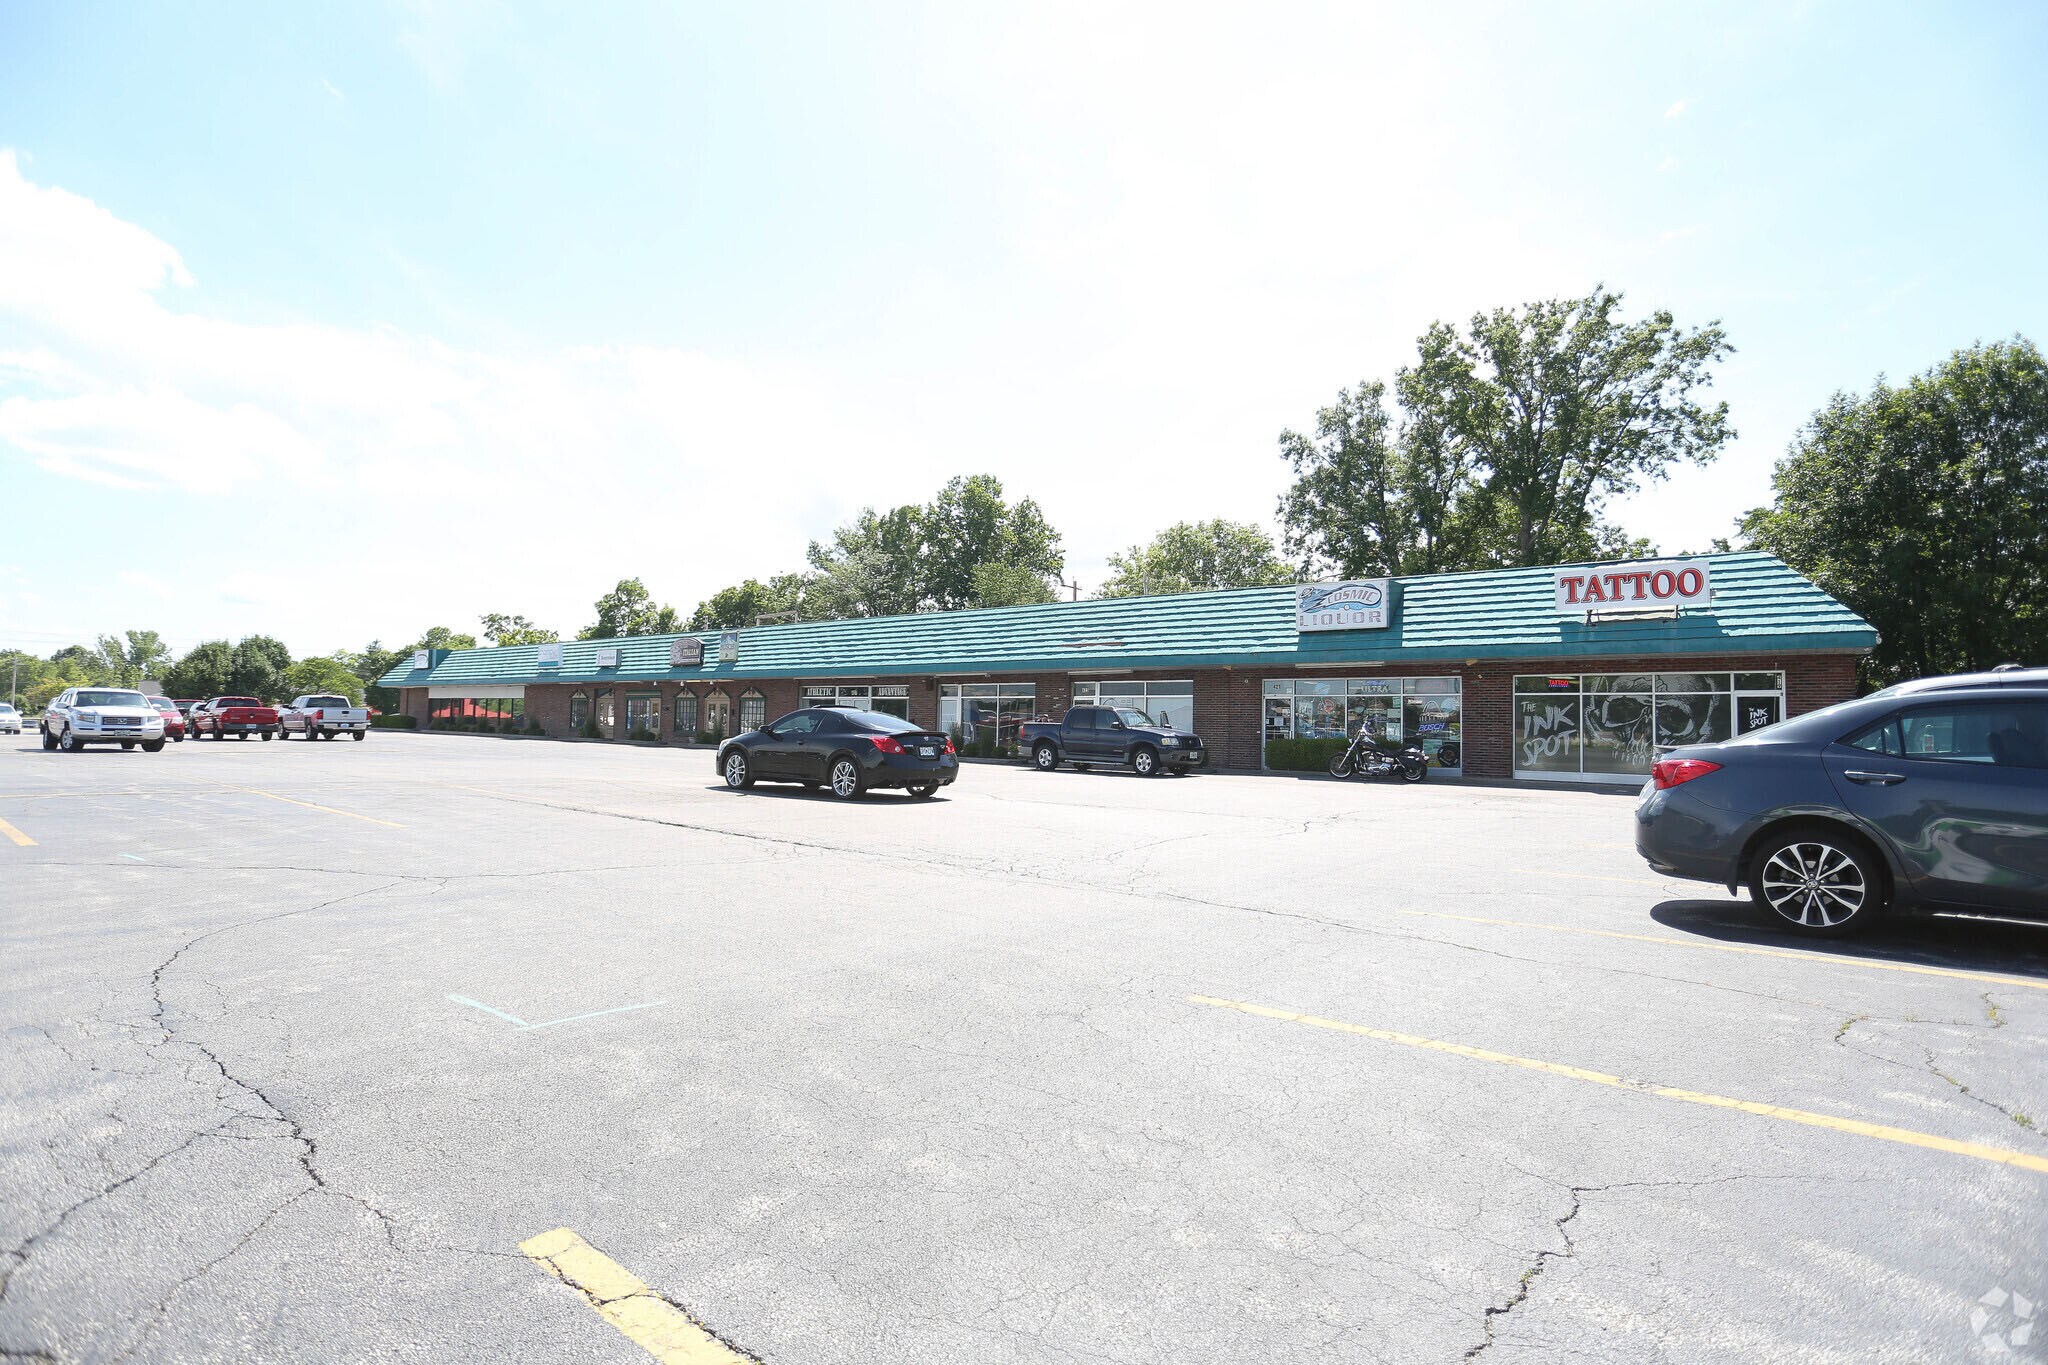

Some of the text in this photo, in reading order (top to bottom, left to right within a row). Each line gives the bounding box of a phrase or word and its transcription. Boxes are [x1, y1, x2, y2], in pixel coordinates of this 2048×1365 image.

[1560, 568, 1704, 604] TATTOO
[1327, 589, 1378, 604] COSMIC
[1299, 610, 1382, 627] LIQUOR
[807, 687, 833, 696] ATHLETIC
[878, 687, 908, 696] ADVANTAGE
[1361, 685, 1389, 693] ULTRA
[1521, 701, 1537, 713] THE
[1749, 707, 1768, 720] INK
[1418, 722, 1445, 732] BUSCH
[1523, 702, 1576, 739] INK
[1749, 715, 1769, 729] SPOT
[1522, 729, 1578, 766] SPOT
